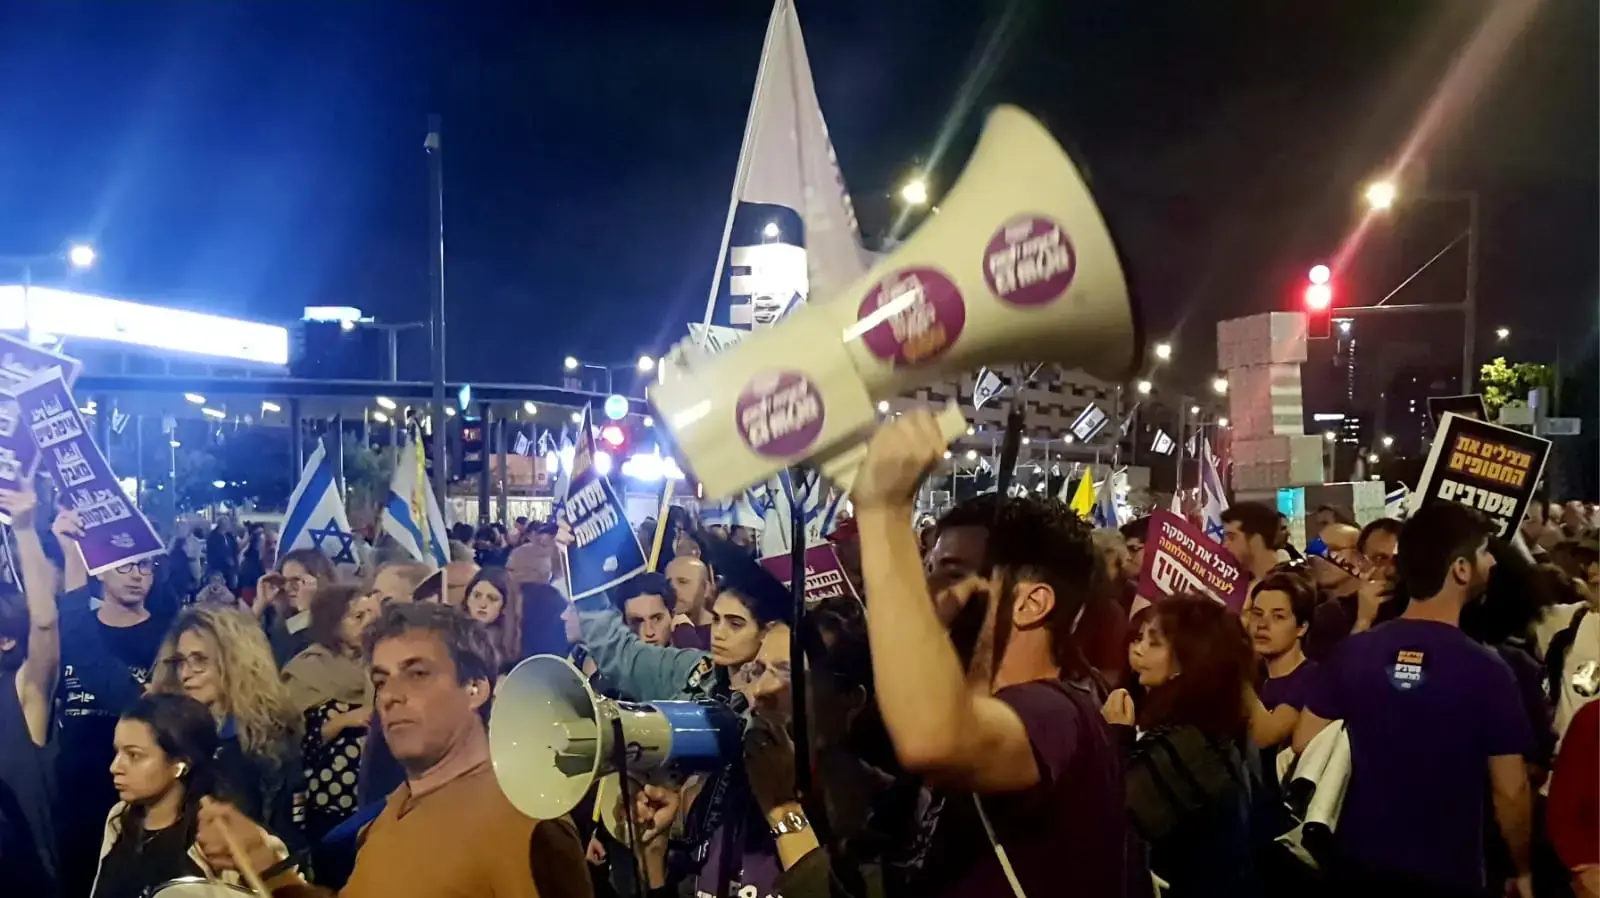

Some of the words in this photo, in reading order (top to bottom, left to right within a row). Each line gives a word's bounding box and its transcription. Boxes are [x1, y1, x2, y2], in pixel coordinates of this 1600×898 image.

[1456, 436, 1480, 455] את
[1480, 442, 1532, 468] מצילים
[1450, 452, 1528, 486] החטופים
[565, 479, 608, 525] מסרבים
[1437, 478, 1518, 517] מסרבים
[574, 501, 619, 549] למלחמה
[1162, 521, 1195, 554] העסקה
[1158, 536, 1192, 566] המלחמה
[1195, 544, 1213, 564] את
[805, 571, 839, 588] מחזיר
[1191, 559, 1206, 576] את
[1213, 553, 1240, 581] לקבל
[1207, 568, 1234, 595] לעצור
